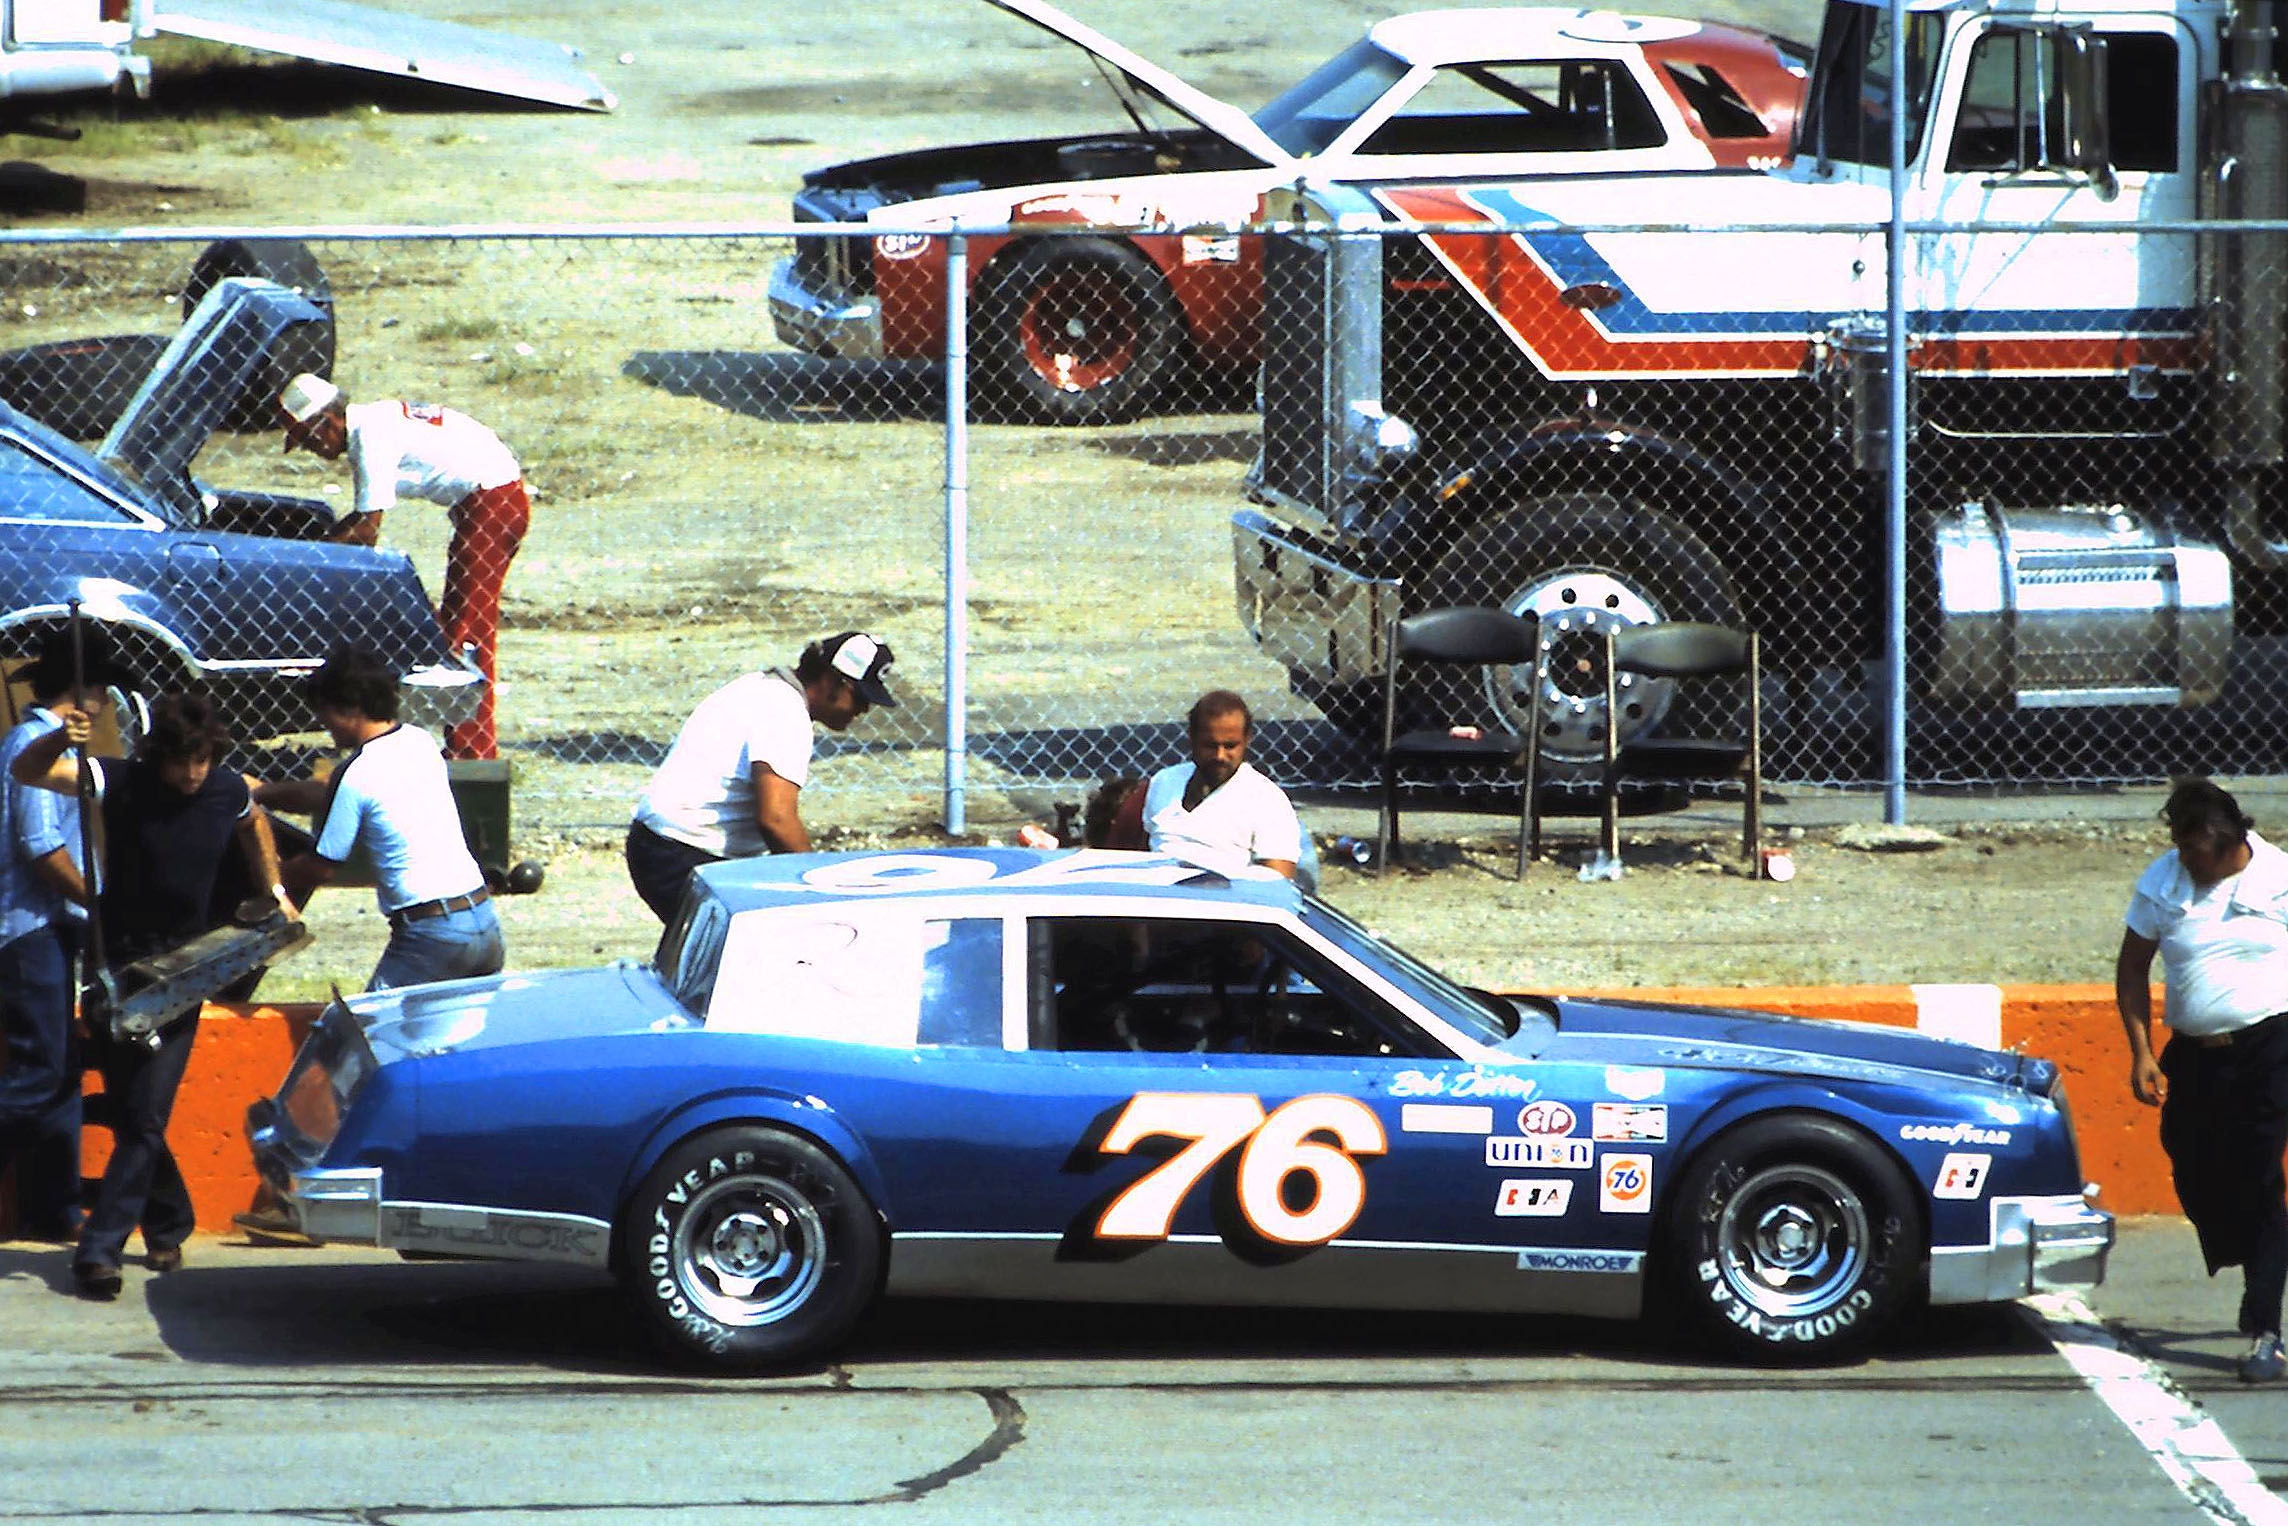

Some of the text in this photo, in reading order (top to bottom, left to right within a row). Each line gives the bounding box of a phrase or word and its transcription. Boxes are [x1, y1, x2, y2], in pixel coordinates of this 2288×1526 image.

[1900, 1123, 2012, 1146] GOODYEAR
[1094, 1091, 1388, 1247] 76
[1611, 1167, 1640, 1190] 76
[1539, 1253, 1621, 1271] MONROE
